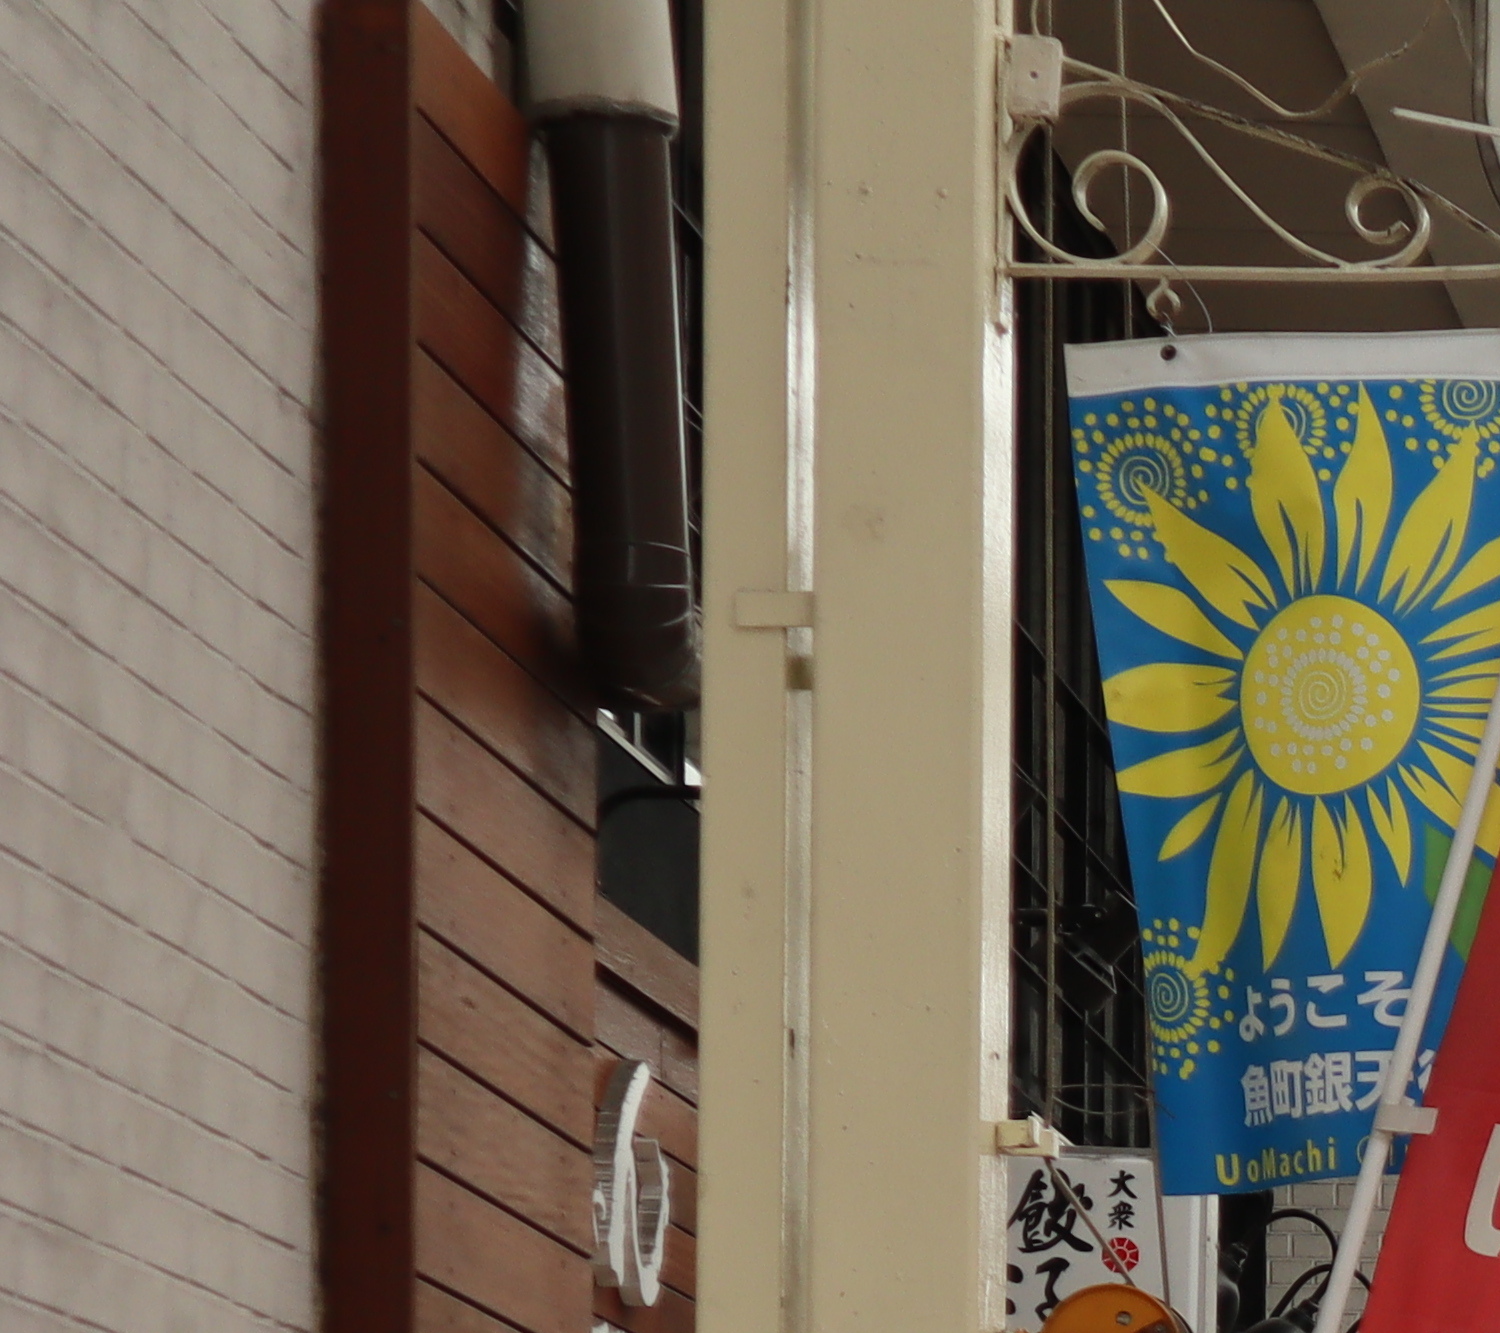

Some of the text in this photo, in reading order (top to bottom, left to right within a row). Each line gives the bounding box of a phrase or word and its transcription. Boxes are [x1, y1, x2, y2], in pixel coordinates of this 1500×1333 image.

[1238, 970, 1413, 1043] ようこそ
[1240, 1049, 1437, 1128] 魚町銀天
[1215, 1136, 1338, 1187] UoMachi
[1107, 1170, 1139, 1232] 大衆
